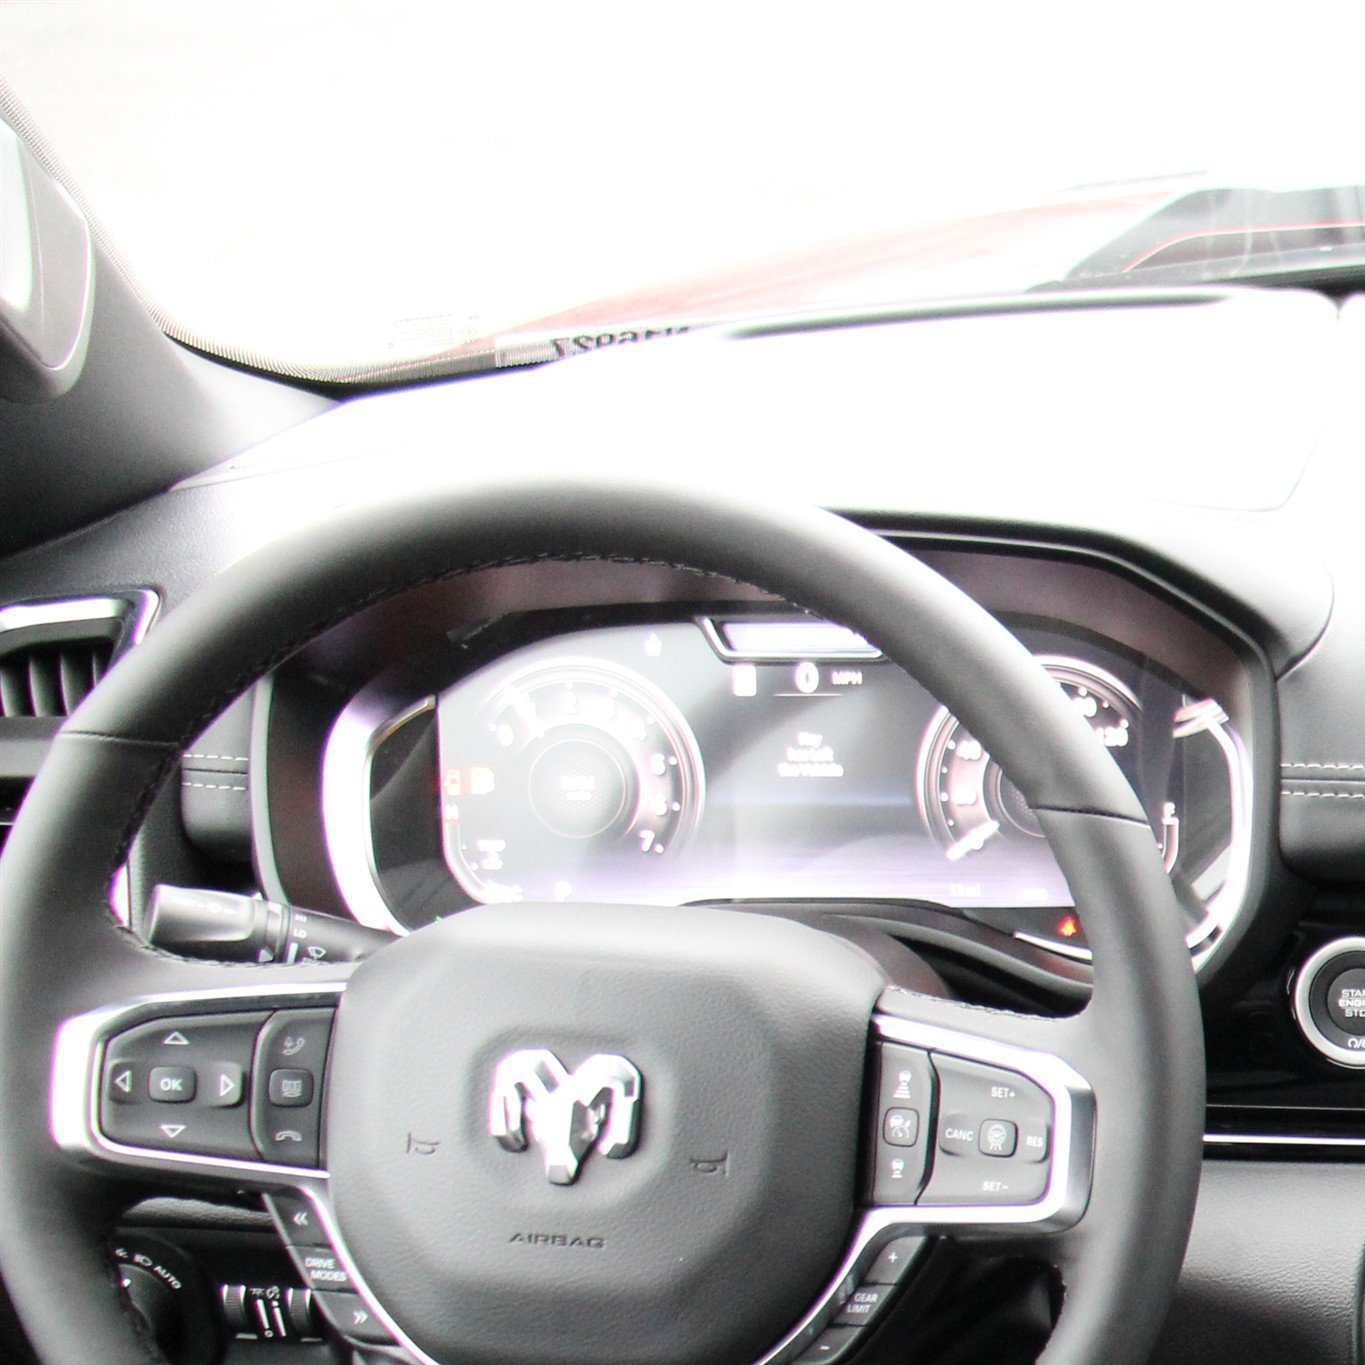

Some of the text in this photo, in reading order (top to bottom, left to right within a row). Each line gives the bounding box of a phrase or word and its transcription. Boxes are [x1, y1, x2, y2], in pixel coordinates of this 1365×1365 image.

[160, 1078, 183, 1091] OK
[945, 1127, 975, 1142] CANC
[1025, 1135, 1044, 1148] RES
[508, 1233, 604, 1249] AIRBAG
[305, 1257, 335, 1269] DRIVE
[153, 1265, 182, 1290] AUTO
[310, 1269, 347, 1282] MODES
[854, 1292, 878, 1303] GEAR
